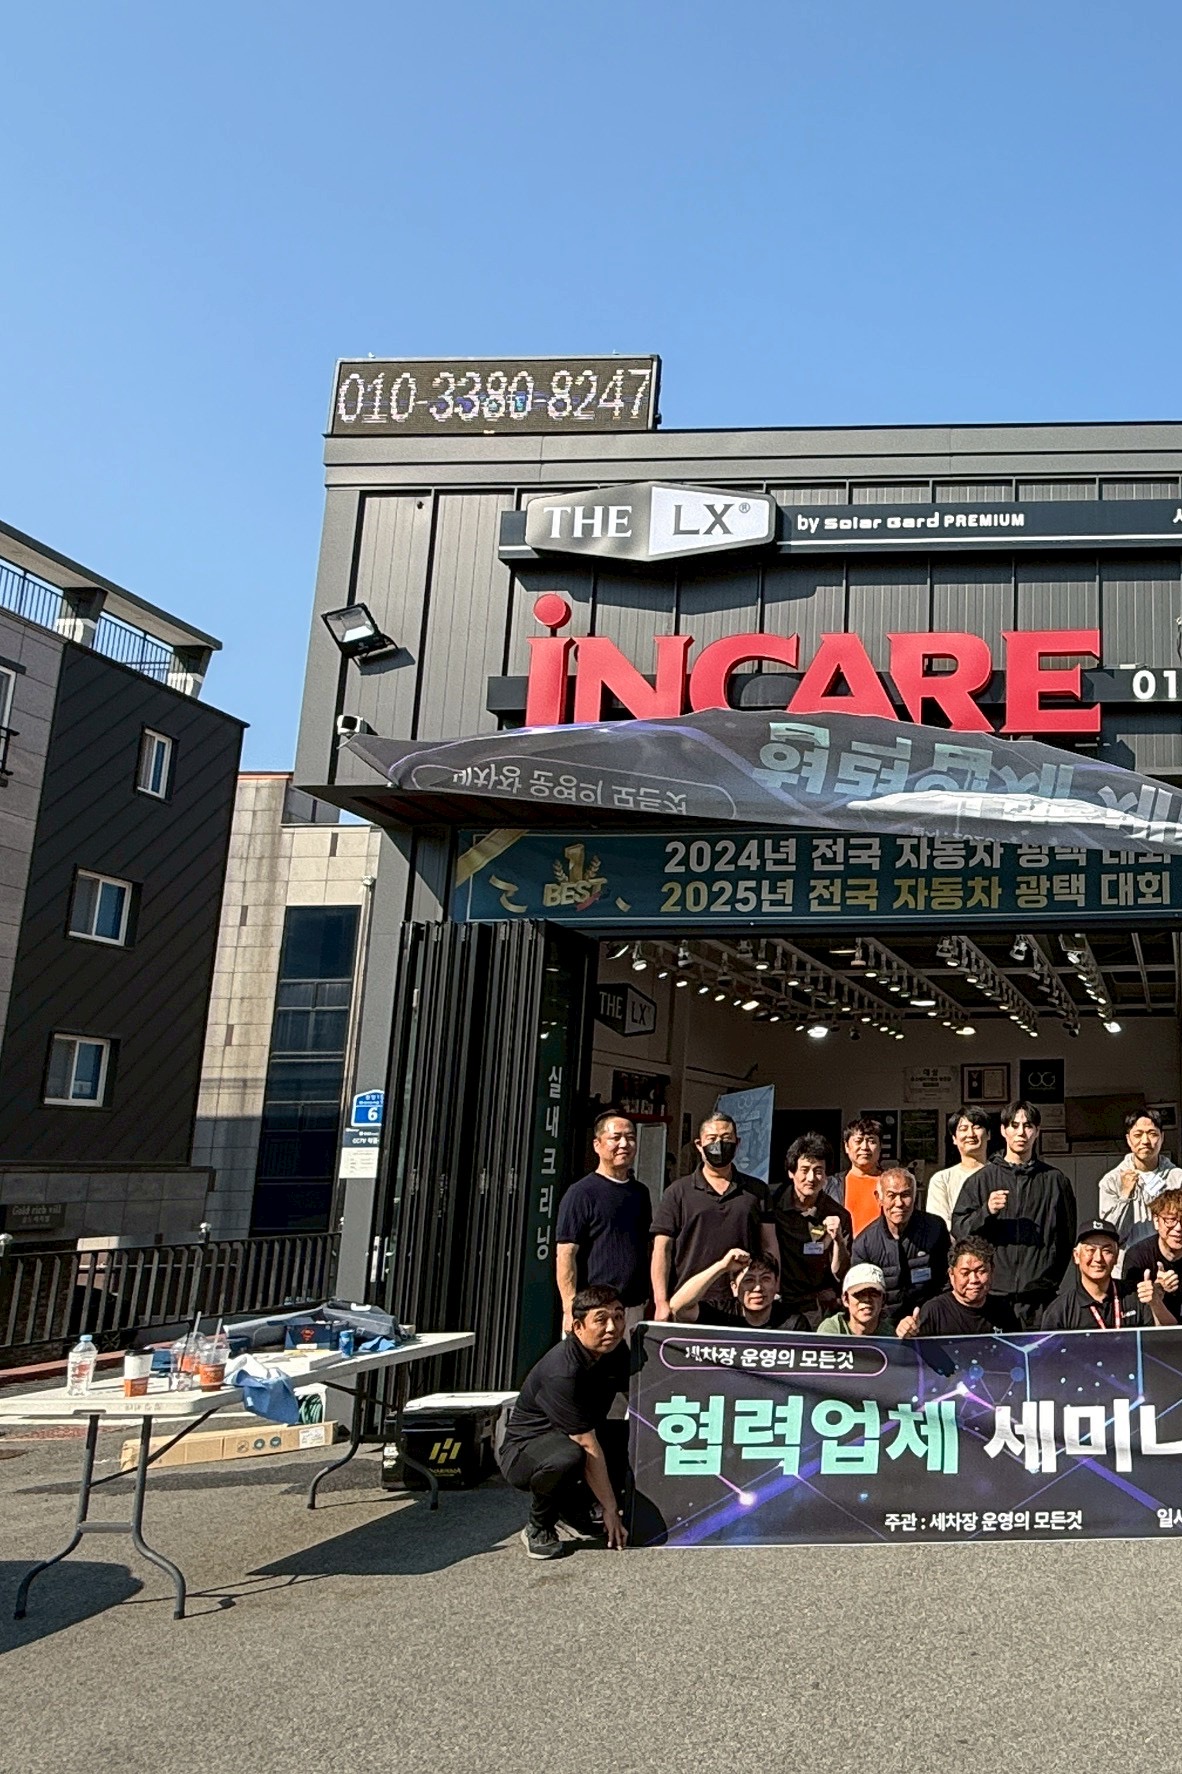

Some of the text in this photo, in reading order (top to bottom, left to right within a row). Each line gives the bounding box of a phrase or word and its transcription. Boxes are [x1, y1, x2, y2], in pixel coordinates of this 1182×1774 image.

[337, 369, 651, 424] 010-3380-8247
[543, 506, 633, 538] THE
[797, 513, 1025, 533] by Solar Gard PREMIUM
[664, 837, 797, 873] 2024년
[811, 837, 881, 870] 전국
[543, 878, 608, 907] BEST
[660, 877, 794, 912] 2025년
[808, 876, 879, 911] 전국
[893, 875, 1001, 910] 자동차
[1015, 873, 1086, 909] 광택
[1101, 871, 1171, 905] 대회
[600, 991, 623, 1020] THE
[367, 1107, 378, 1121] 6
[740, 1348, 796, 1368] 운영의
[799, 1349, 854, 1370] 모든것
[655, 1395, 959, 1475] 협력업체
[885, 1513, 917, 1531] 주관
[930, 1512, 978, 1531] 세차장
[981, 1510, 1030, 1531] 운영의
[1034, 1510, 1083, 1530] 모든것
